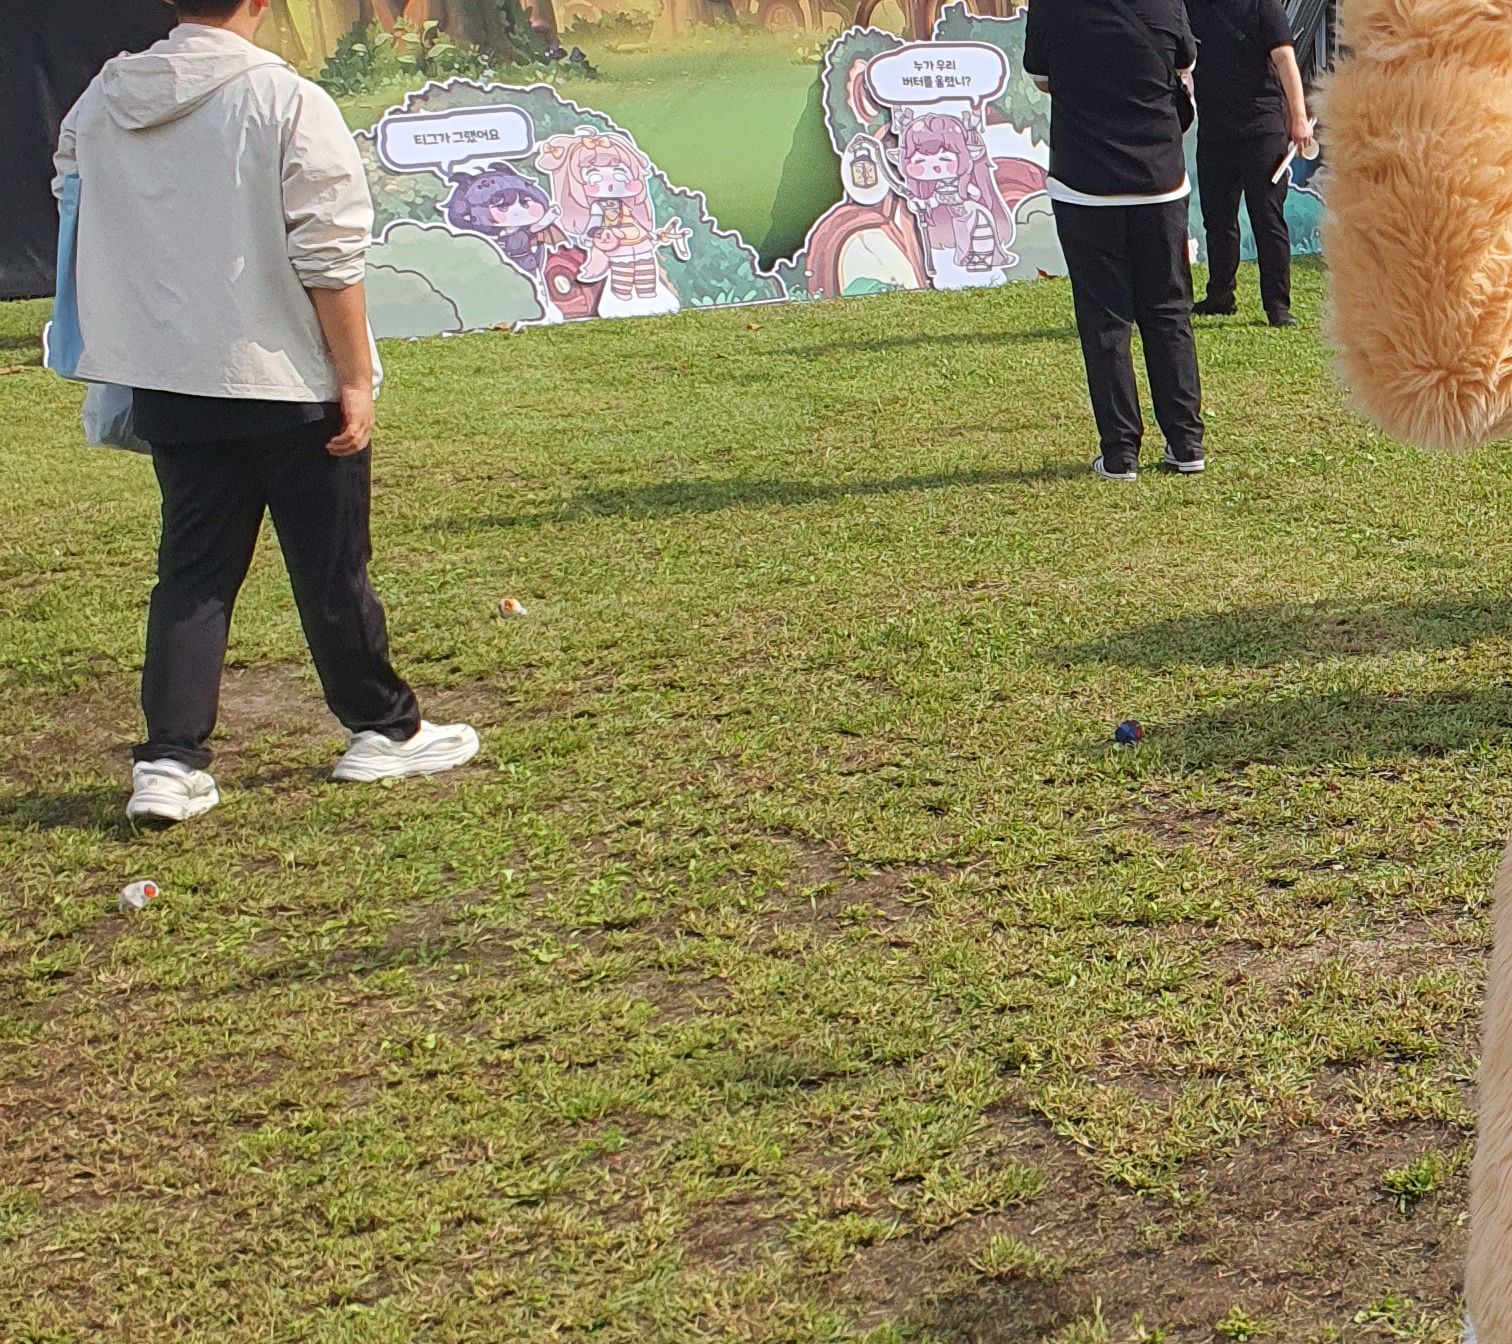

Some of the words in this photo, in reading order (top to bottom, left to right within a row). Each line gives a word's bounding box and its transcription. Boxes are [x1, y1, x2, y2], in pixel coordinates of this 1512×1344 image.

[913, 60, 934, 71] 누가
[936, 59, 956, 71] 우리
[413, 132, 451, 145] 티그가
[452, 128, 501, 144] 그랬어요
